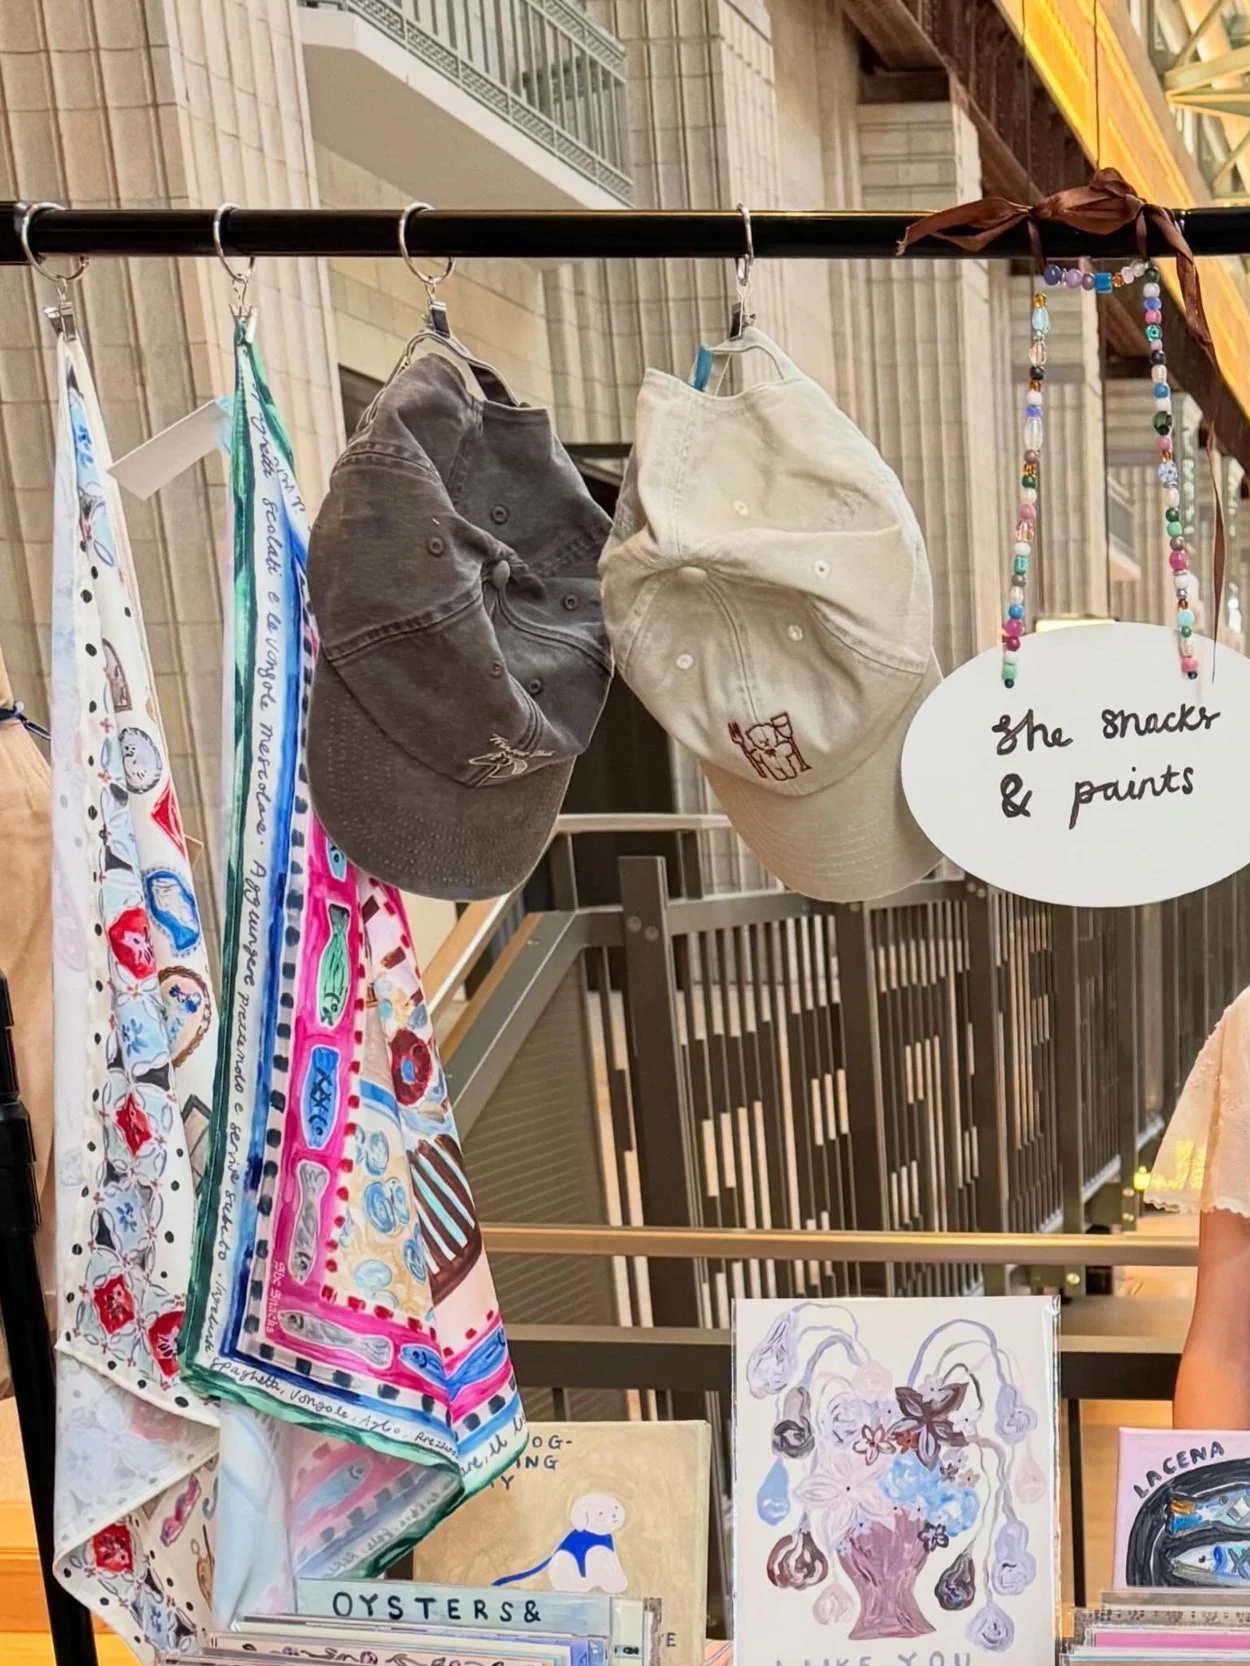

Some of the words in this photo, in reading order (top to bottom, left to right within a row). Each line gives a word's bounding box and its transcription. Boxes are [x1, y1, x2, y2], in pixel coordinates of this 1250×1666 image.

[992, 709, 1073, 755] She
[1000, 773, 1031, 818] &
[1069, 764, 1194, 829] paints
[532, 1434, 573, 1450] OG-
[516, 1455, 558, 1471] ING
